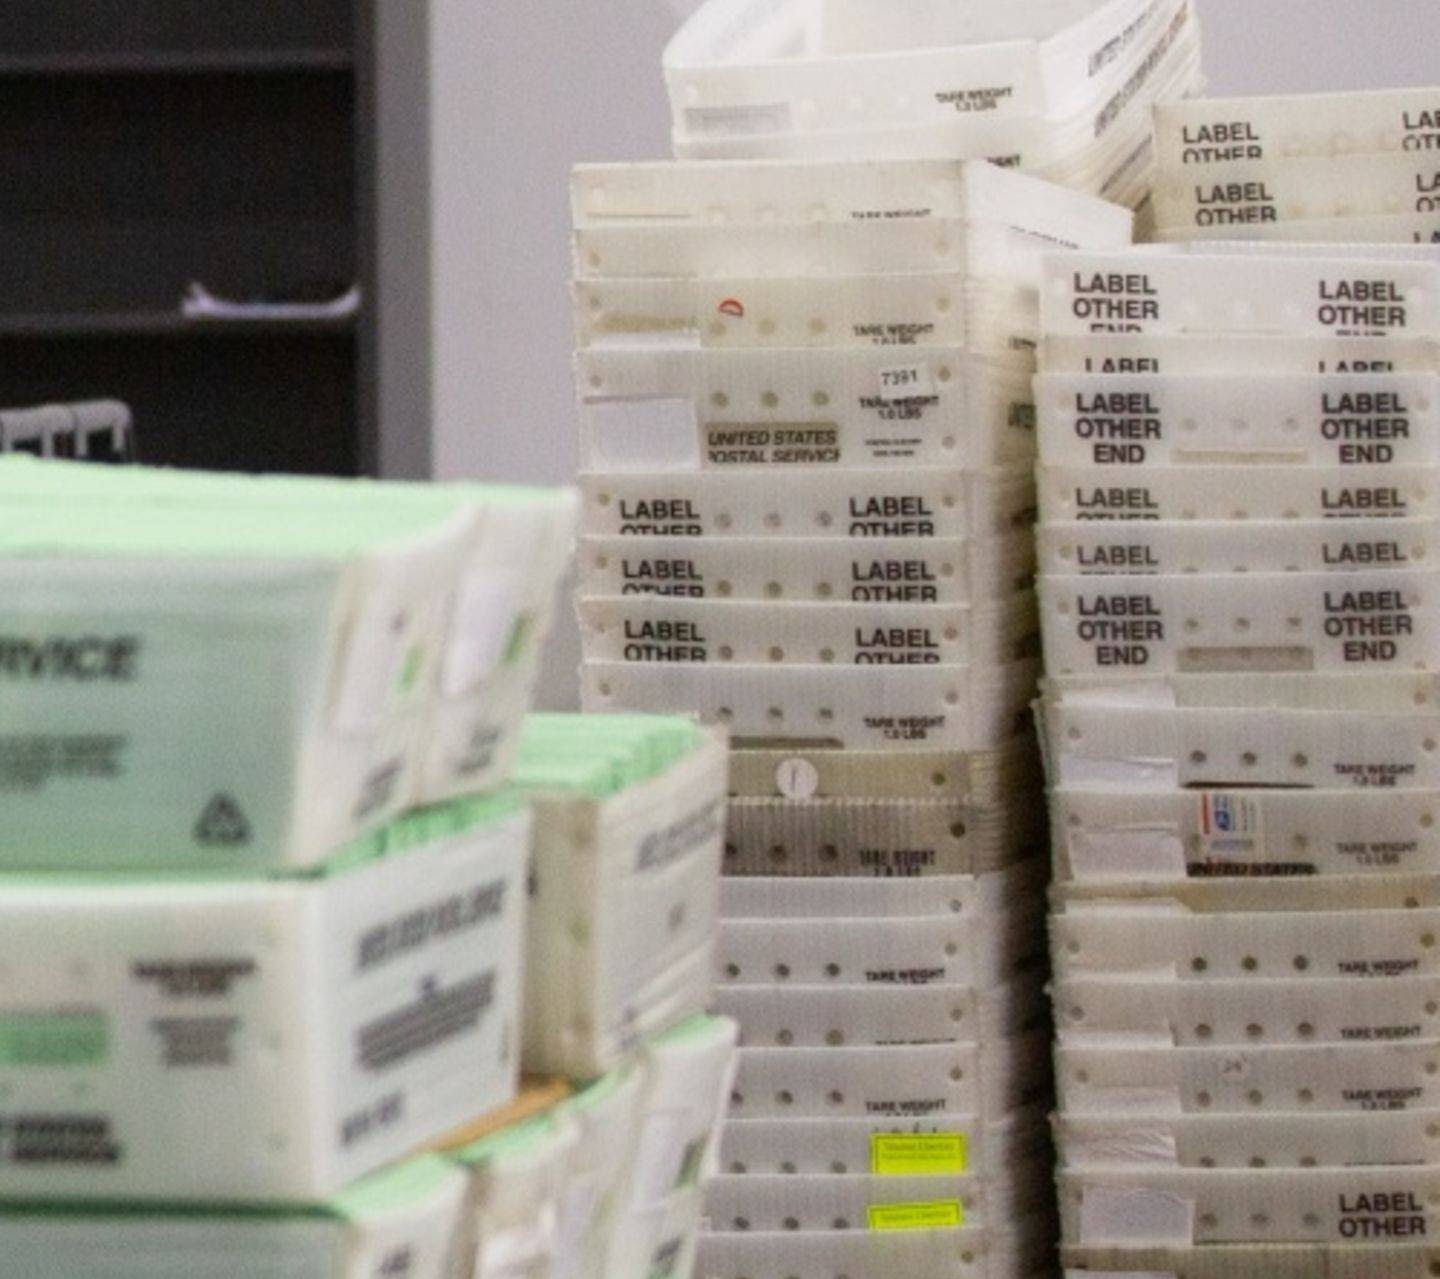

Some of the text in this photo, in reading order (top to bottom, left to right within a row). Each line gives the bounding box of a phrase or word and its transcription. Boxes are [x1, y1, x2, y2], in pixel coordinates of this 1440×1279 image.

[1182, 122, 1260, 144] LABEL
[1182, 147, 1263, 164] OTHER
[1196, 182, 1274, 204] LABEL
[1195, 206, 1278, 227] OTHER
[1073, 272, 1158, 295] LABEL
[1318, 280, 1406, 303] LABEL
[1072, 297, 1160, 321] OTHER
[1317, 305, 1407, 327] OTHER
[1076, 392, 1160, 415] LABEL
[1321, 392, 1407, 414] LABEL
[708, 430, 837, 446] UNITED STATES
[1077, 417, 1163, 440] OTHER
[1322, 417, 1410, 440] OTHER
[1093, 443, 1145, 464] END
[1340, 442, 1394, 464] END
[849, 496, 933, 517] LABEL
[1076, 487, 1159, 509] LABEL
[1321, 487, 1406, 509] LABEL
[619, 499, 700, 520] LABEL
[1077, 544, 1159, 565] LABEL
[1322, 542, 1406, 563] LABEL
[622, 560, 702, 581] LABEL
[851, 560, 936, 581] LABEL
[1078, 595, 1162, 617] LABEL
[1324, 591, 1410, 614] LABEL
[624, 621, 706, 642] LABEL
[1078, 619, 1165, 641] OTHER
[1324, 615, 1413, 638] OTHER
[855, 627, 940, 649] LABEL
[624, 643, 707, 661] OTHER
[1096, 644, 1148, 666] END
[1343, 640, 1397, 662] END
[1338, 1194, 1424, 1214] LABEL
[1338, 1216, 1427, 1238] OTHER
